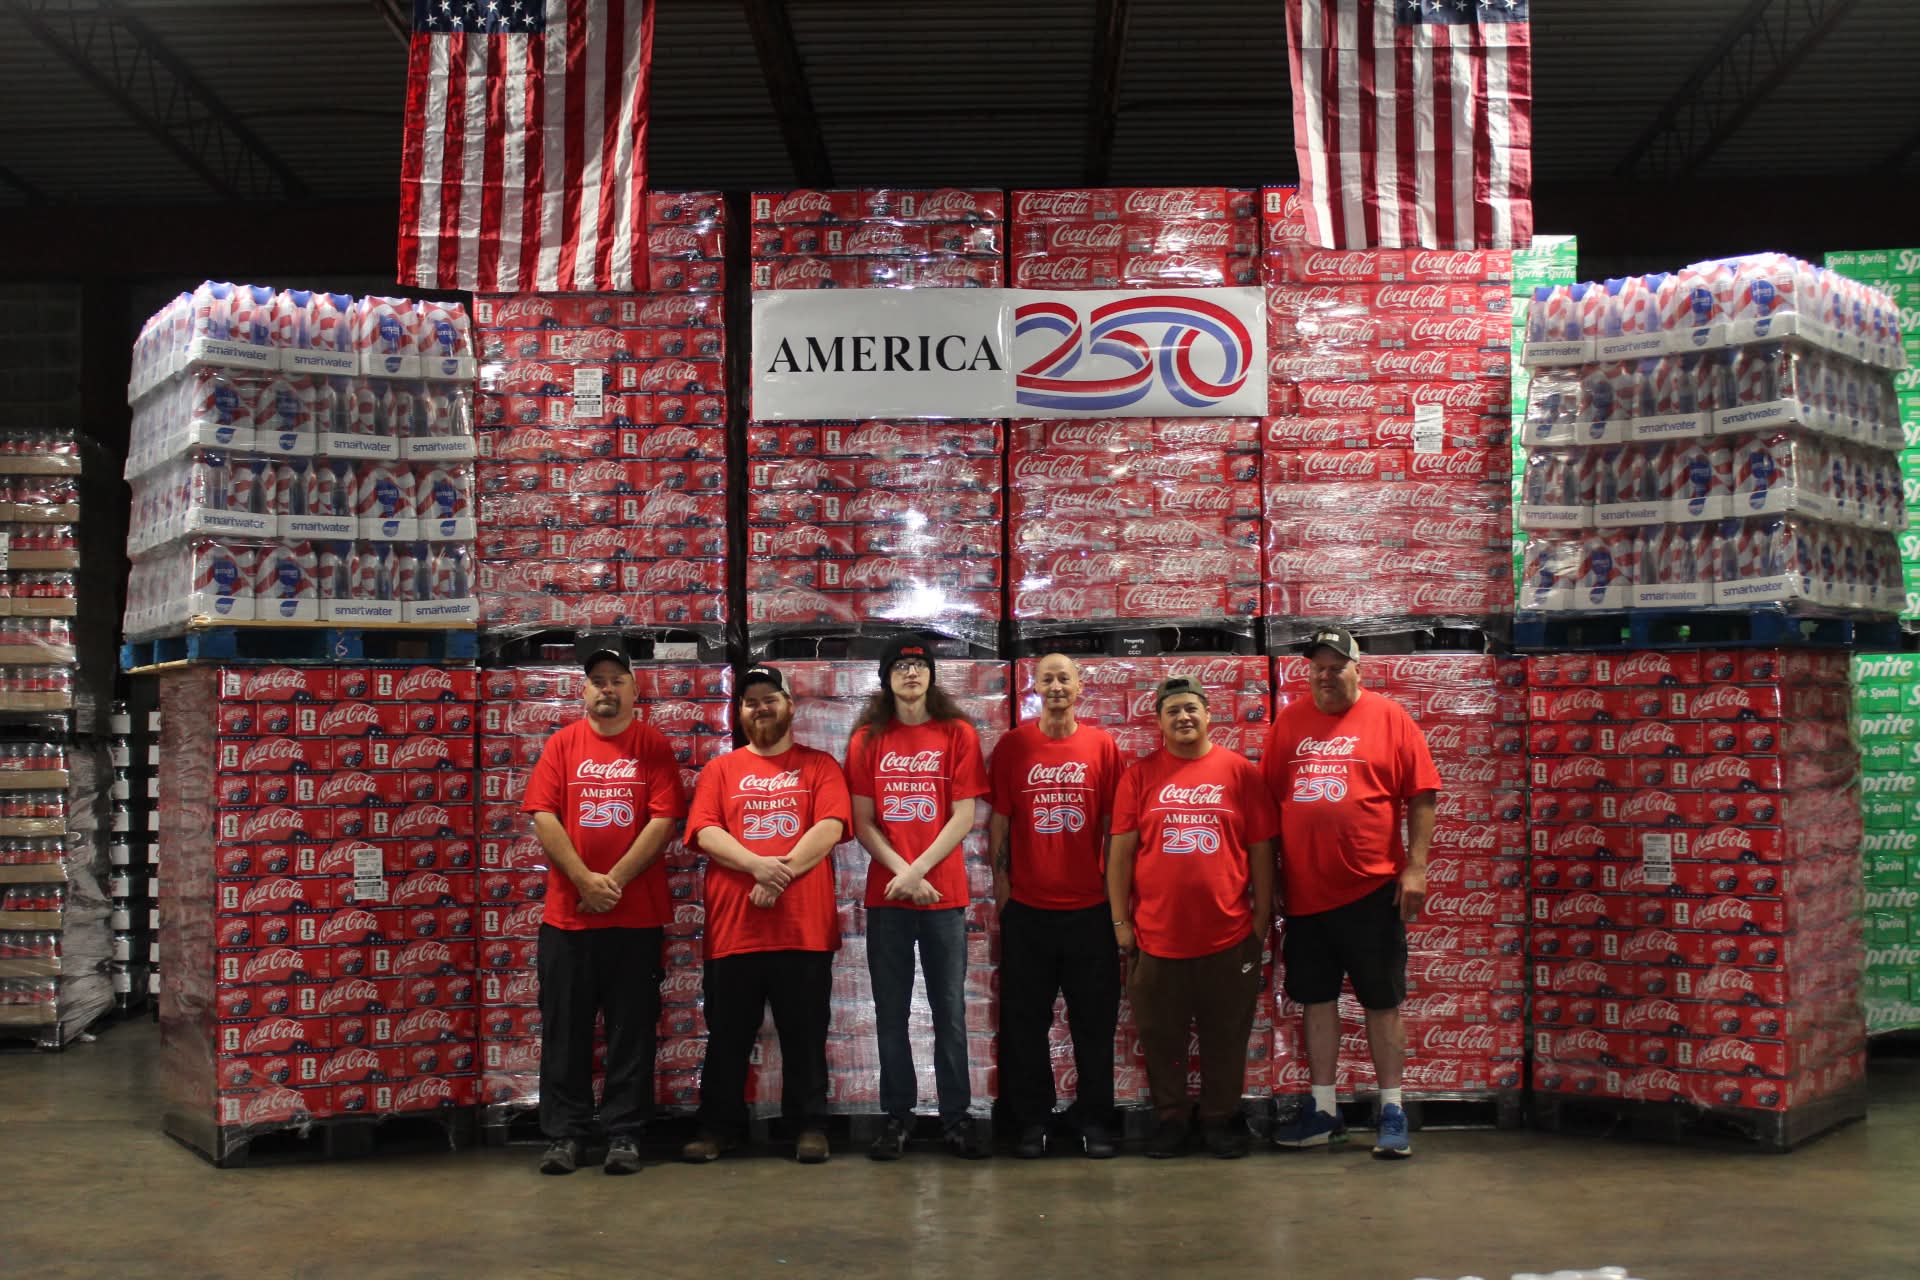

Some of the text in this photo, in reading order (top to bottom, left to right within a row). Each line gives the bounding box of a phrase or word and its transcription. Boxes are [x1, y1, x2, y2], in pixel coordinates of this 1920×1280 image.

[775, 193, 831, 223] Coca-Cola
[920, 191, 976, 220] Coca-Cola
[1018, 192, 1090, 215] Coca-Cola
[1125, 191, 1199, 213] Coca-Cola
[1052, 224, 1126, 247] Coca-Cola
[1018, 257, 1090, 281] Coca-Cola
[1305, 251, 1377, 276] Coca-Cola
[1412, 251, 1485, 275] Coca-Cola
[1827, 255, 1855, 266] Sprite
[1858, 254, 1887, 265] Sprite
[775, 259, 831, 289] Coca-Cola
[1376, 285, 1448, 308] Coca-Cola
[497, 298, 553, 326] Coca-Cola
[1411, 317, 1485, 341] Coca-Cola
[206, 344, 267, 361] smartwater
[767, 295, 1253, 411] AMERICA 250
[1527, 347, 1581, 357] smartwater
[1603, 339, 1661, 354] smartwater
[295, 355, 352, 368] smartwater
[1376, 351, 1448, 375] Coca-Cola
[641, 362, 698, 391] Coca-Cola
[1304, 384, 1377, 408] Coca-Cola
[1412, 383, 1487, 407] Coca-Cola
[1639, 420, 1696, 435] smartwater
[1722, 407, 1782, 425] smartwater
[844, 425, 902, 453] Coca-Cola
[1052, 421, 1124, 445] Coca-Cola
[1160, 420, 1234, 443] Coca-Cola
[1269, 417, 1341, 442] Coca-Cola
[334, 439, 391, 452] smartwater
[413, 442, 467, 452] smartwater
[641, 428, 699, 457] Coca-Cola
[772, 459, 829, 488] Coca-Cola
[1015, 455, 1087, 478] Coca-Cola
[1305, 451, 1377, 475] Coca-Cola
[1412, 450, 1486, 474] Coca-Cola
[570, 462, 627, 492] Coca-Cola
[1052, 487, 1124, 511] Coca-Cola
[1161, 486, 1232, 509] Coca-Cola
[204, 515, 265, 529] smartwater
[1526, 511, 1579, 521] smartwater
[1601, 509, 1658, 520] smartwater
[291, 522, 350, 532] smartwater
[1124, 520, 1195, 543] Coca-Cola
[1413, 517, 1486, 540] Coca-Cola
[570, 529, 627, 559] Coca-Cola
[771, 526, 828, 556] Coca-Cola
[1052, 554, 1124, 577] Coca-Cola
[1124, 585, 1197, 609] Coca-Cola
[1414, 582, 1487, 607] Coca-Cola
[1640, 591, 1697, 601] smartwater
[1722, 582, 1783, 597] smartwater
[335, 607, 393, 616] smartwater
[416, 604, 472, 615] smartwater
[1393, 658, 1467, 681] Coca-Cola
[1615, 653, 1671, 685] Coca-Cola
[246, 668, 306, 700] Coca-Cola
[396, 669, 452, 700] Coca-Cola
[1871, 686, 1900, 700] Sprite
[1550, 689, 1604, 720] Coca-Cola
[1690, 687, 1749, 718] Coca-Cola
[320, 703, 379, 735] Coca-Cola
[1296, 736, 1360, 756] Coca-Cola
[1619, 722, 1675, 754] Coca-Cola
[243, 739, 304, 771] Coca-Cola
[393, 738, 448, 768] Coca-Cola
[880, 751, 944, 773] Coca-Cola
[1871, 744, 1901, 757] Sprite
[577, 759, 639, 779] Coca-Cola
[739, 769, 800, 791] Coca-Cola
[1028, 761, 1088, 785] Coca-Cola
[1297, 764, 1348, 774] AMERICA
[1552, 757, 1605, 788] Coca-Cola
[1692, 757, 1750, 788] Coca-Cola
[318, 772, 376, 804] Coca-Cola
[581, 788, 633, 797] AMERICA
[884, 782, 936, 792] AMERICA
[1033, 793, 1083, 804] AMERICA
[1159, 783, 1225, 805] Coca-Cola
[1293, 776, 1347, 802] 250
[579, 800, 634, 827] 250
[744, 797, 797, 810] AMERICA
[883, 795, 937, 822] 250
[1620, 792, 1676, 822] Coca-Cola
[1873, 802, 1903, 815] Sprite
[243, 809, 304, 840] Coca-Cola
[392, 806, 448, 837] Coca-Cola
[744, 811, 800, 840] 250
[1034, 805, 1086, 833] 250
[1164, 814, 1218, 824] AMERICA
[1163, 826, 1220, 854] 250
[1552, 826, 1605, 855] Coca-Cola
[1693, 828, 1751, 857] Coca-Cola
[1875, 861, 1905, 874] Sprite
[243, 876, 304, 912] Coca-Cola
[393, 873, 448, 905] Coca-Cola
[1425, 892, 1499, 916] Coca-Cola
[1553, 894, 1606, 923] Coca-Cola
[1694, 899, 1752, 928] Coca-Cola
[320, 910, 378, 943] Coca-Cola
[1622, 931, 1678, 960] Coca-Cola
[244, 949, 304, 982] Coca-Cola
[394, 942, 450, 974] Coca-Cola
[1425, 959, 1497, 983] Coca-Cola
[1554, 962, 1607, 991] Coca-Cola
[1696, 969, 1754, 999] Coca-Cola
[320, 980, 378, 1013] Coca-Cola
[395, 1010, 450, 1042] Coca-Cola
[1623, 1000, 1679, 1029] Coca-Cola
[245, 1018, 304, 1052] Coca-Cola
[1424, 1025, 1497, 1049] Coca-Cola
[1555, 1030, 1607, 1059] Coca-Cola
[321, 1049, 380, 1082] Coca-Cola
[1697, 1040, 1755, 1069] Coca-Cola
[395, 1078, 451, 1110] Coca-Cola
[1624, 1069, 1680, 1098] Coca-Cola
